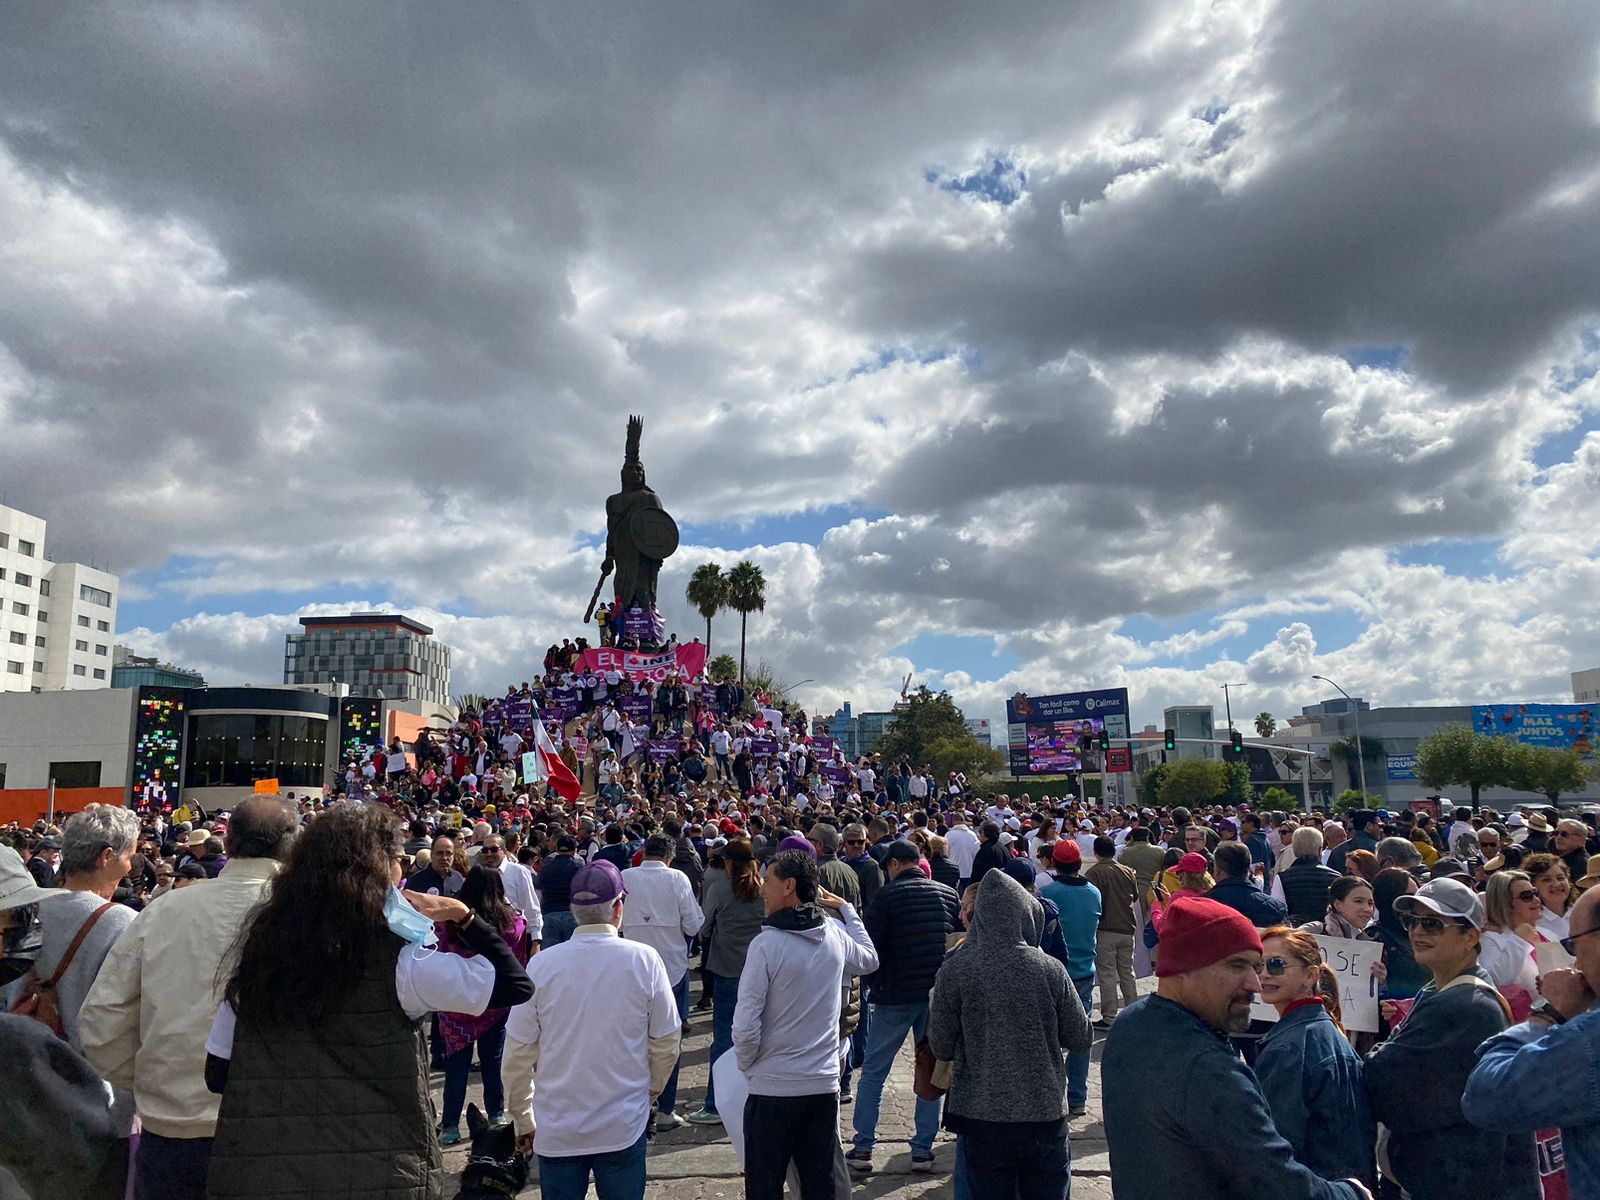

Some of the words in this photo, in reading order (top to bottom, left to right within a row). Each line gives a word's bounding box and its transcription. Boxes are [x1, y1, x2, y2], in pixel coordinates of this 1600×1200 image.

[598, 652, 622, 666] EL
[643, 652, 676, 665] INE
[643, 664, 690, 680] TOA
[1095, 699, 1120, 708] Calimax
[1523, 717, 1553, 726] MAX
[1515, 727, 1564, 736] JUNTOS
[1335, 950, 1360, 976] SE
